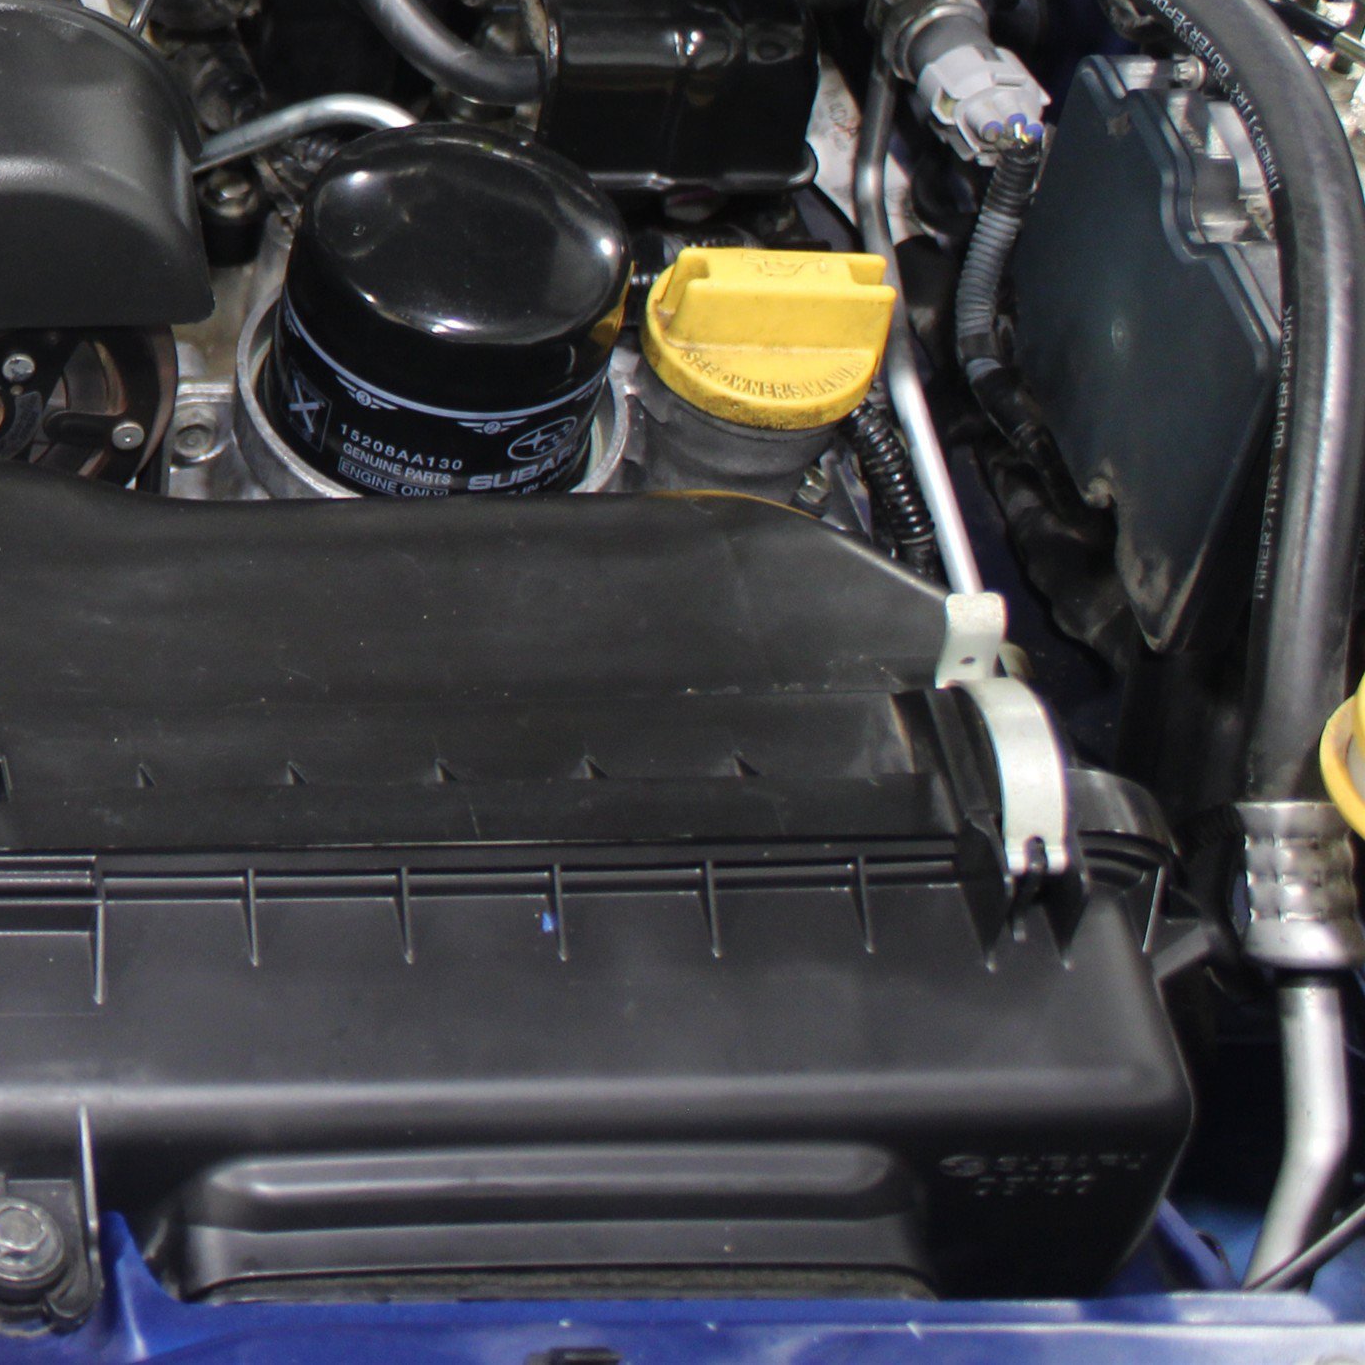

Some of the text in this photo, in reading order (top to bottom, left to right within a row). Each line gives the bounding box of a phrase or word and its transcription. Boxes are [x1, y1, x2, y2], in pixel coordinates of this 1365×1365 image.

[683, 350, 718, 377] SEE
[340, 423, 463, 471] 15208AA130
[342, 441, 451, 486] GENUINE PARTS
[467, 444, 573, 491] SUBAR
[340, 461, 398, 493] ENGINE
